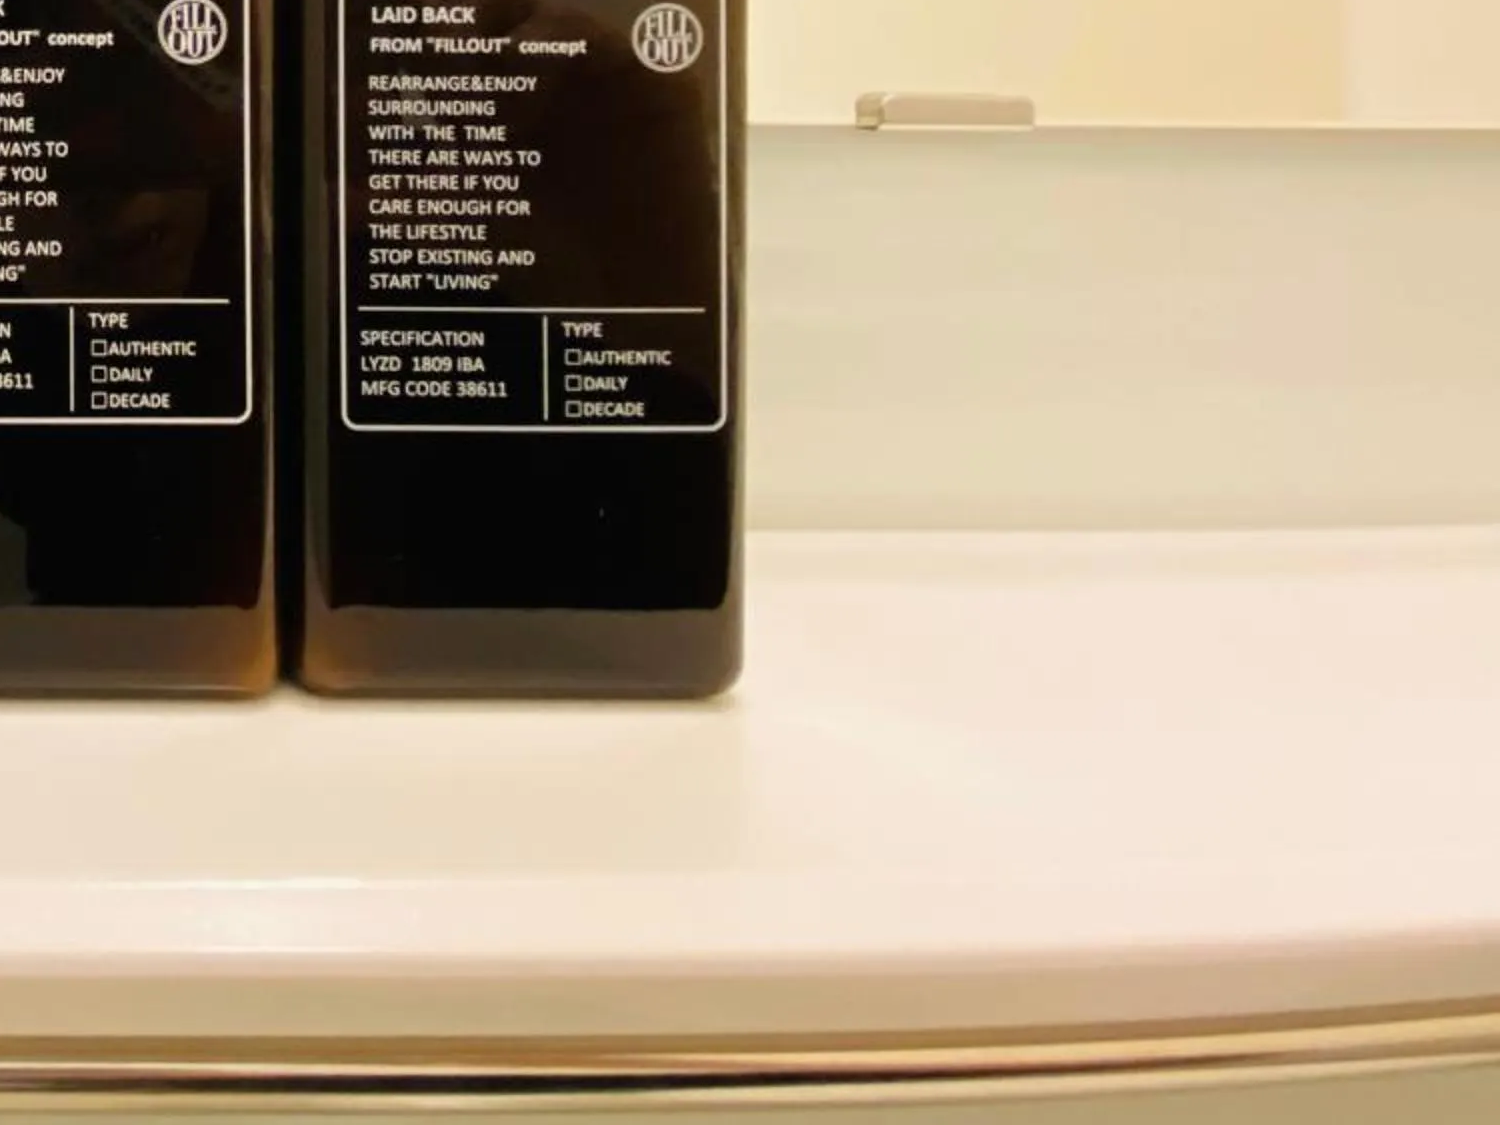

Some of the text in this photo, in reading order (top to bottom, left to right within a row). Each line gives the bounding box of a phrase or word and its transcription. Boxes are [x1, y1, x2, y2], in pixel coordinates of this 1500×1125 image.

[170, 3, 216, 30] FILL
[371, 5, 476, 24] LAID BACK
[644, 10, 690, 37] FILL
[46, 31, 115, 49] concept
[168, 30, 217, 58] OUT
[369, 36, 587, 58] FROM "FILLOUT" concept
[643, 37, 692, 64] OUT
[368, 74, 538, 92] REARRANGE&ENJOY
[367, 98, 496, 117] SURROUNDING
[367, 123, 507, 142] WITH THE TIME
[44, 140, 69, 158] TO
[367, 148, 542, 167] THERE ARE WAYS TO
[10, 165, 48, 183] YOU
[368, 173, 520, 192] GET THERE IF YOU
[24, 190, 59, 207] FOR
[368, 198, 531, 216] CARE ENOUGH FOR
[368, 223, 487, 241] THE LIFESTYLE
[24, 239, 63, 257] AND
[368, 248, 536, 266] STOP EXISTING AND
[369, 272, 499, 291] START "LIVING"
[87, 312, 129, 330] TYPE
[561, 321, 603, 338] TYPE
[360, 329, 485, 348] SPECIFICATION
[107, 340, 197, 357] AUTHENTIC
[581, 349, 672, 366] AUTHENTIC
[360, 355, 485, 373] LYZD 1809 IBA
[108, 366, 153, 383] DAILY
[582, 375, 629, 392] DAILY
[361, 380, 508, 398] MFG CODE 38611
[108, 392, 171, 409] DECADE
[582, 401, 645, 418] DECADE
